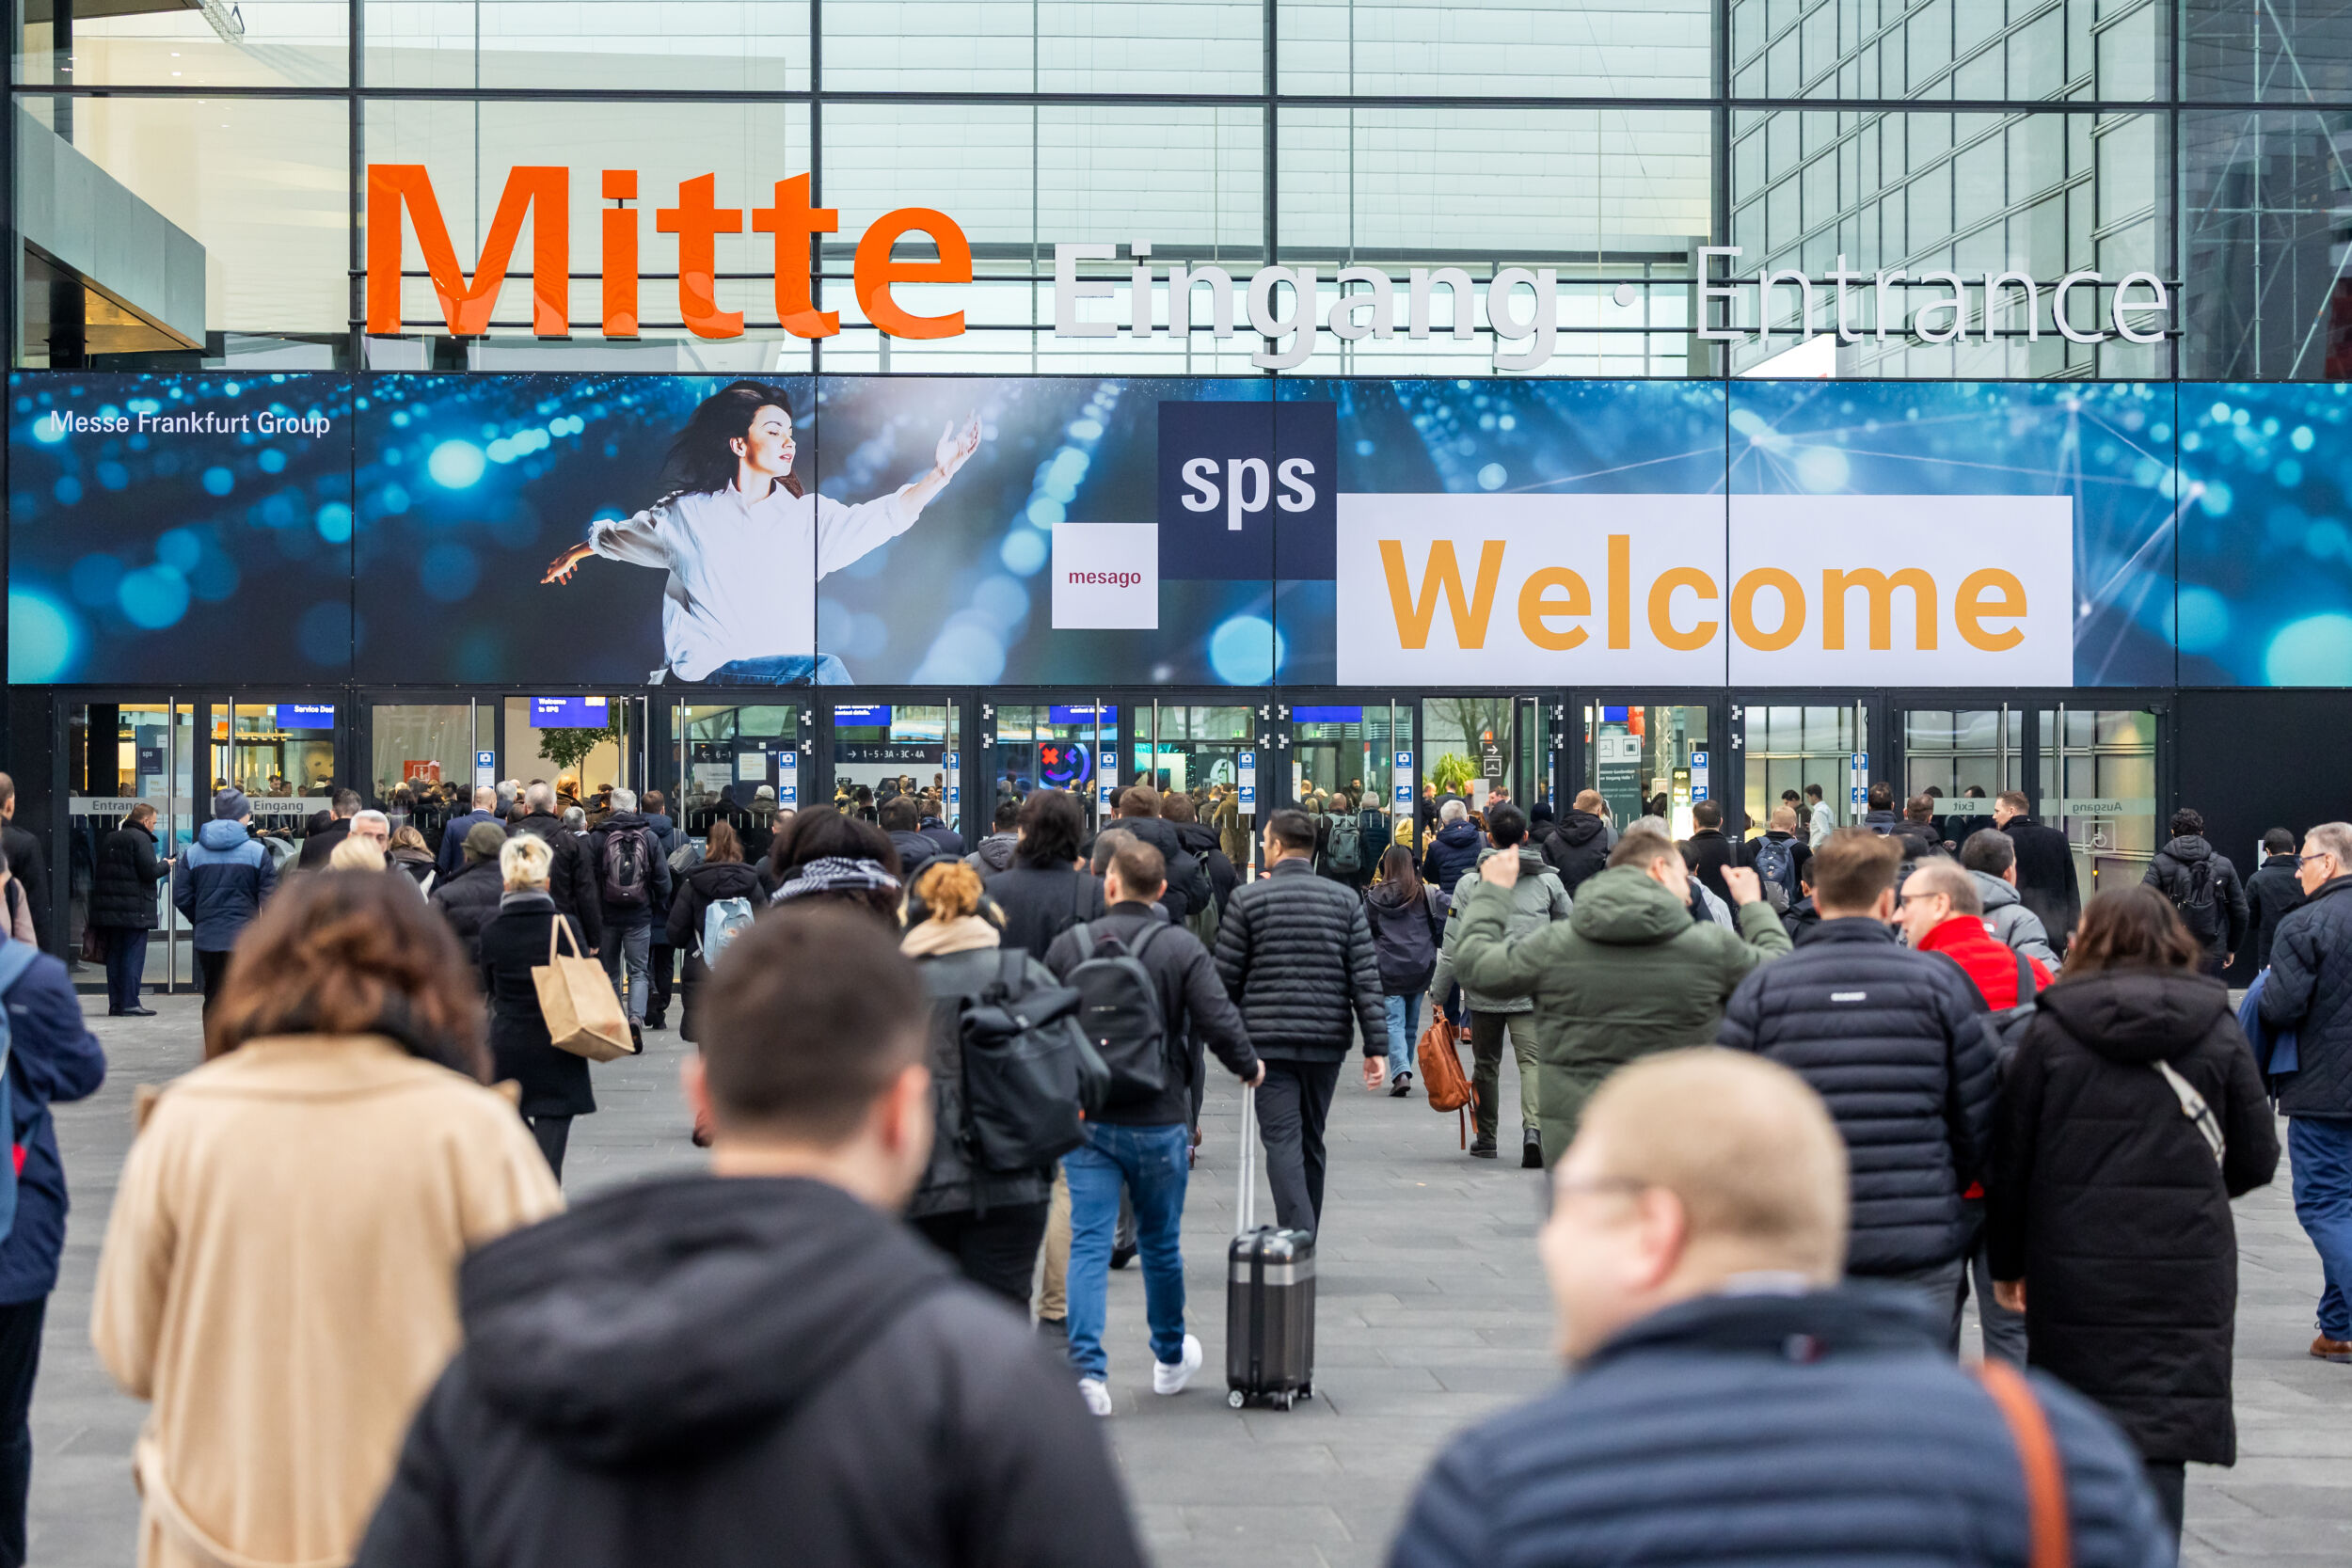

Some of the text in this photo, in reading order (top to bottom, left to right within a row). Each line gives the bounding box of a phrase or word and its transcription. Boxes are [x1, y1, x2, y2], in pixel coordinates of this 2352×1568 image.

[368, 164, 973, 340] Mitte
[1055, 239, 1557, 371] Eingang
[1697, 245, 2168, 344] Entrance
[51, 411, 330, 438] Messe Frankfurt Group
[1181, 457, 1316, 531] sps
[1069, 571, 1141, 588] mesago
[1377, 534, 2027, 652] Welcome
[294, 705, 319, 713] Service
[254, 800, 304, 814] Eingang
